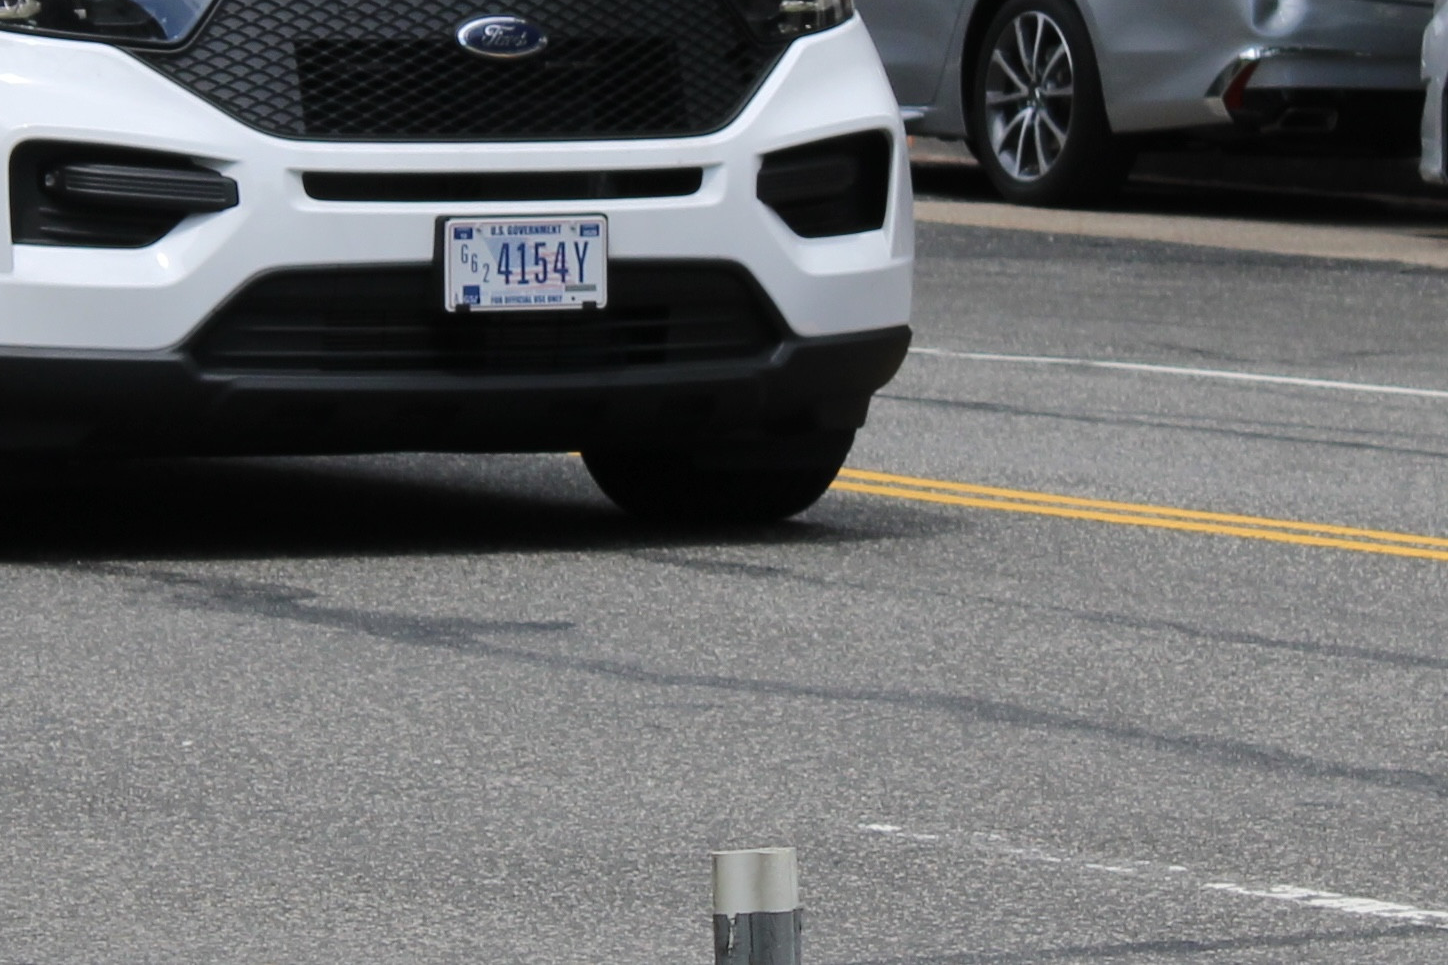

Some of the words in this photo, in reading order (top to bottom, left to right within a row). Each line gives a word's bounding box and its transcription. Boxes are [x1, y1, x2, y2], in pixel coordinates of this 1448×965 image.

[481, 24, 528, 47] Ford
[491, 225, 505, 236] U.S.
[507, 224, 562, 235] GOVERNMENT
[497, 241, 589, 285] 4154Y
